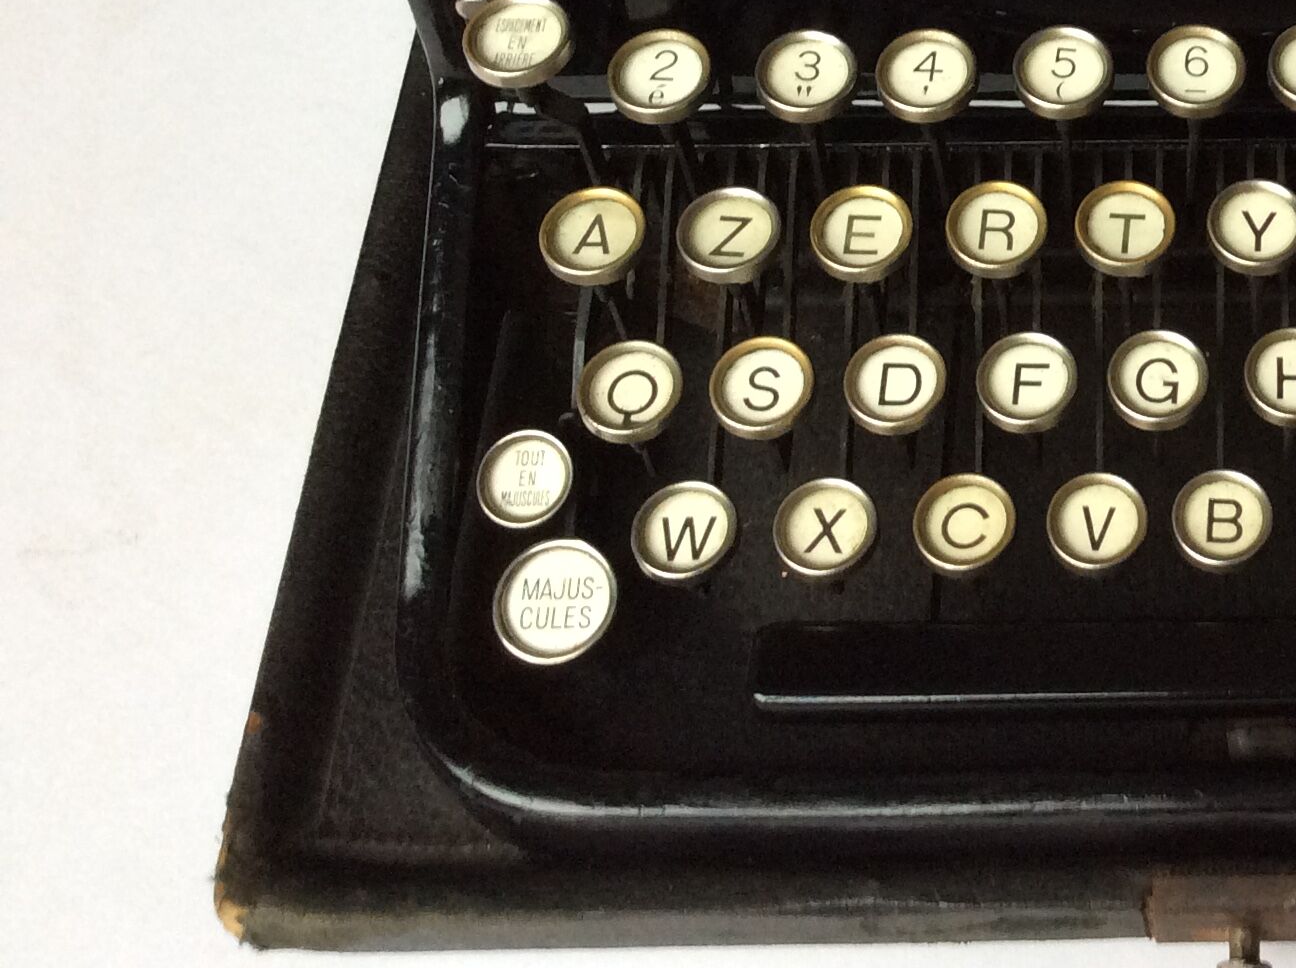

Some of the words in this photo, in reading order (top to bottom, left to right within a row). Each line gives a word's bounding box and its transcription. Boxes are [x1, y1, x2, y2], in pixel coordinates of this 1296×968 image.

[508, 34, 528, 50] EN
[1185, 46, 1208, 77] 6
[650, 50, 678, 81] 2
[795, 51, 821, 81] 3
[913, 51, 943, 82] 4
[1051, 48, 1076, 78] 5
[573, 214, 609, 254] A
[709, 216, 752, 257] Z
[843, 214, 882, 255] E
[978, 209, 1015, 250] R
[1109, 213, 1146, 254] T
[1242, 211, 1276, 252] Y
[607, 370, 658, 425] Q
[743, 367, 780, 411] S
[878, 363, 922, 406] D
[1012, 363, 1050, 405] F
[1136, 358, 1179, 404] G
[515, 449, 546, 466] TOUT
[519, 470, 537, 486] EN
[662, 517, 716, 562] W
[804, 508, 846, 553] X
[941, 503, 989, 549] C
[1083, 506, 1115, 551] V
[1206, 498, 1242, 543] B
[522, 576, 604, 601] MAJUS-
[519, 605, 592, 630] CULES
